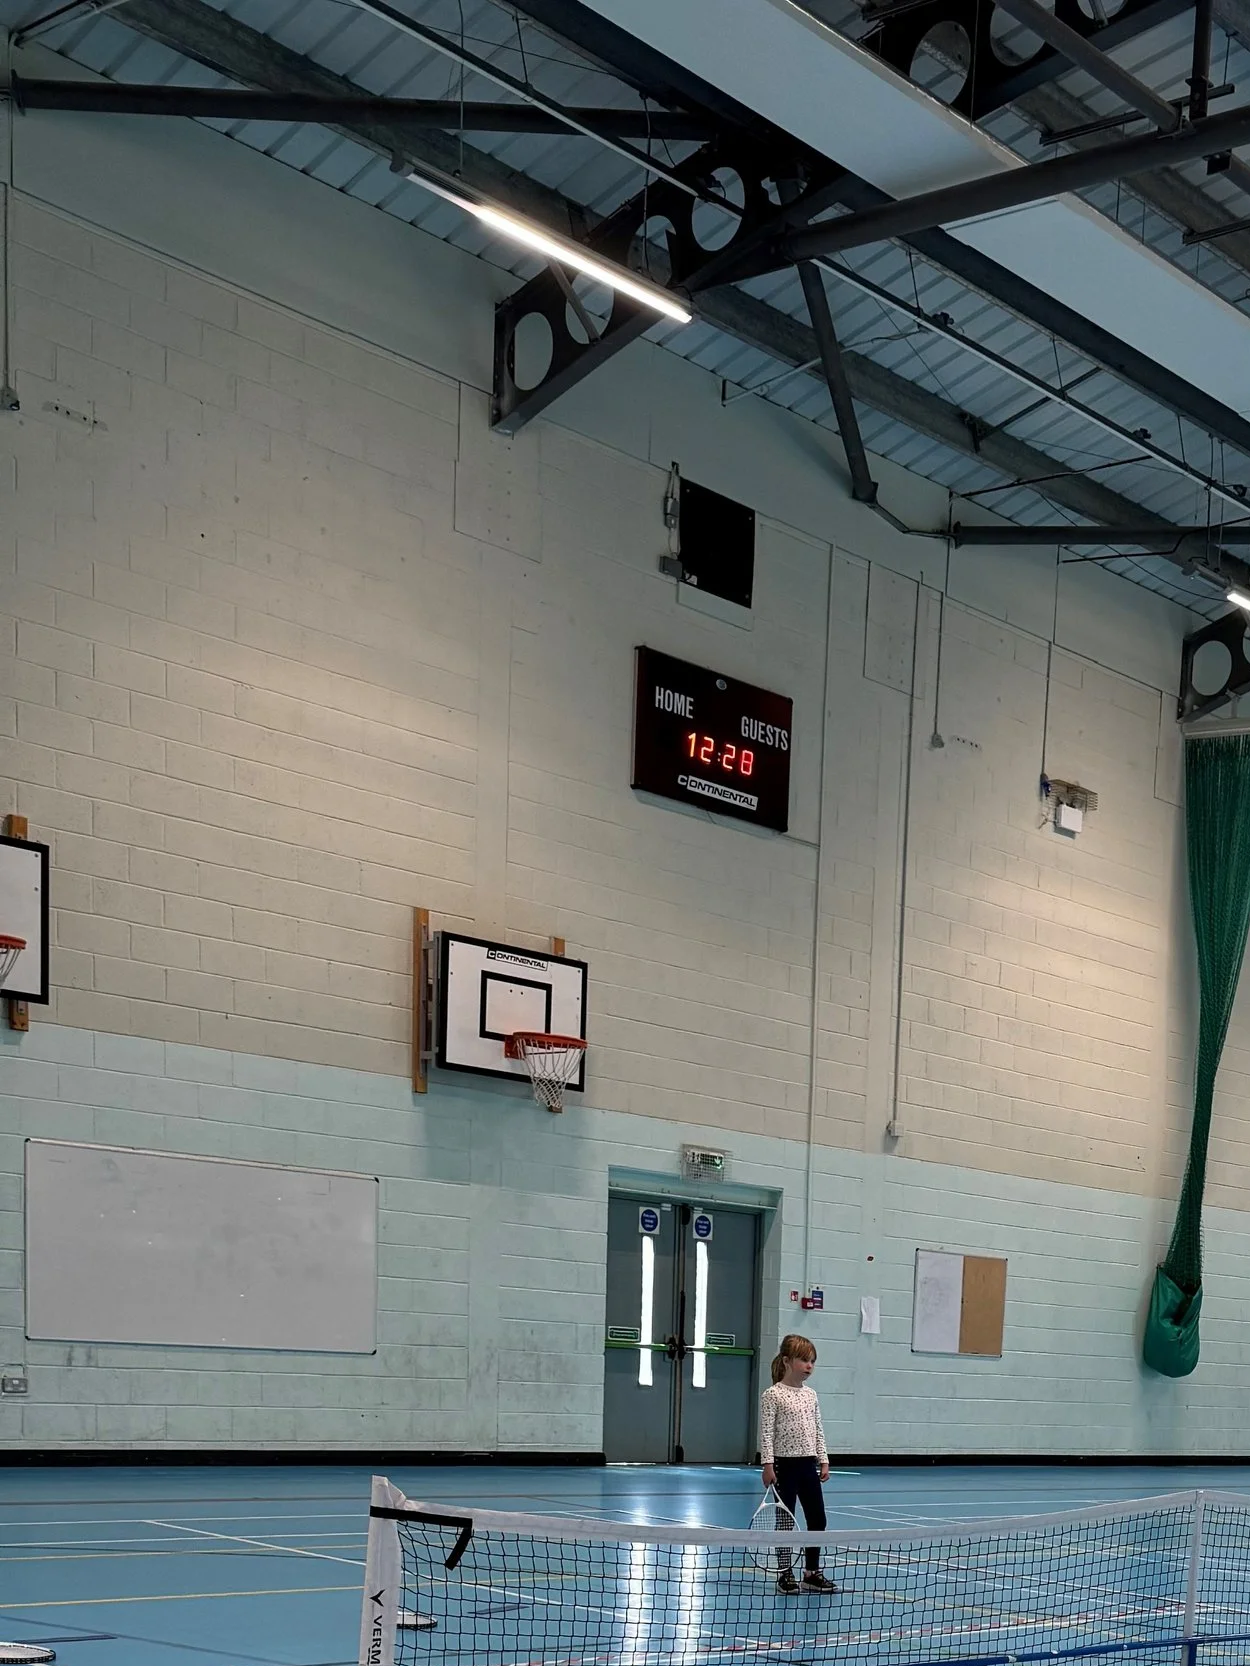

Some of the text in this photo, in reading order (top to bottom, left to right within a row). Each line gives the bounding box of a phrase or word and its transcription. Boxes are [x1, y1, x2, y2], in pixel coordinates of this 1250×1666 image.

[655, 685, 694, 719] HOME
[741, 715, 789, 751] GUESTS
[688, 732, 754, 776] 12:28
[677, 774, 758, 810] CONTINENTAL
[487, 949, 546, 969] CONTINENTAL
